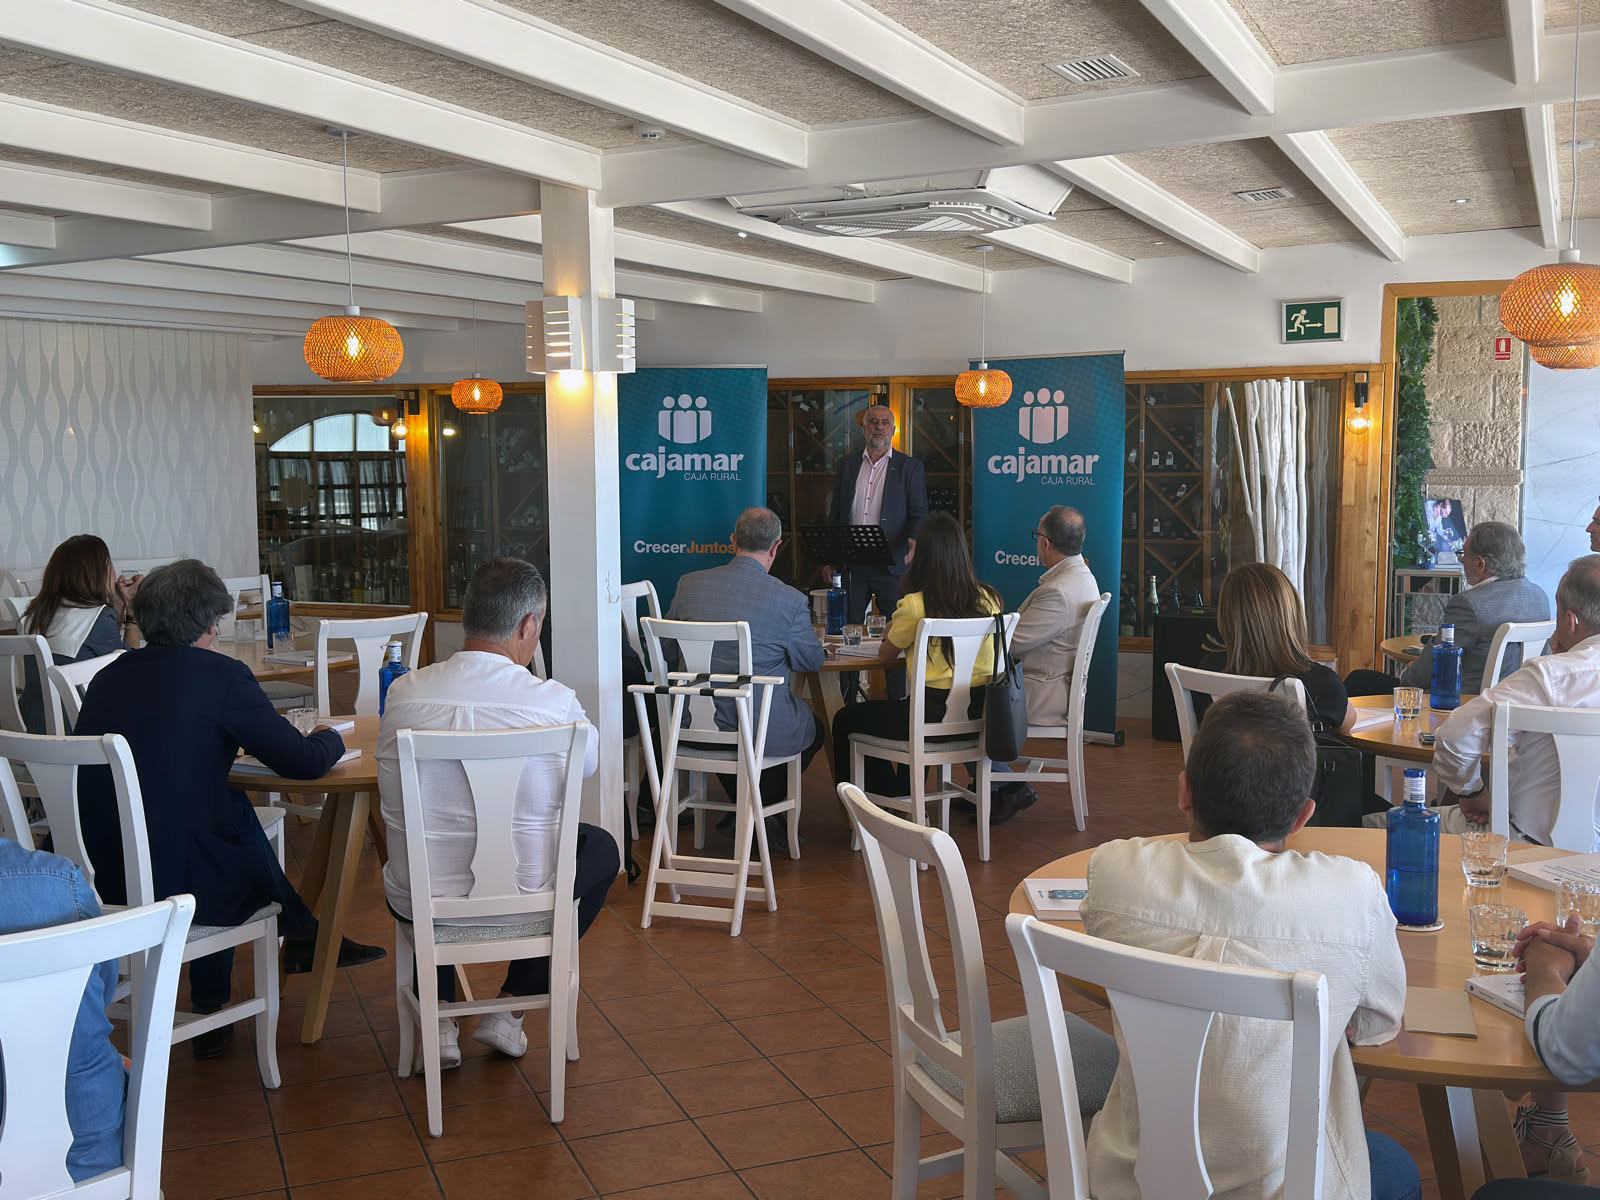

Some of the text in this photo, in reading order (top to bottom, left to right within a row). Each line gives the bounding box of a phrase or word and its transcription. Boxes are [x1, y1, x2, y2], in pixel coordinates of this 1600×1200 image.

[625, 446, 744, 479] cajamar
[987, 446, 1100, 483] cajamar
[683, 472, 741, 481] CAJA RURAL
[1041, 476, 1096, 486] CAJA RURAL
